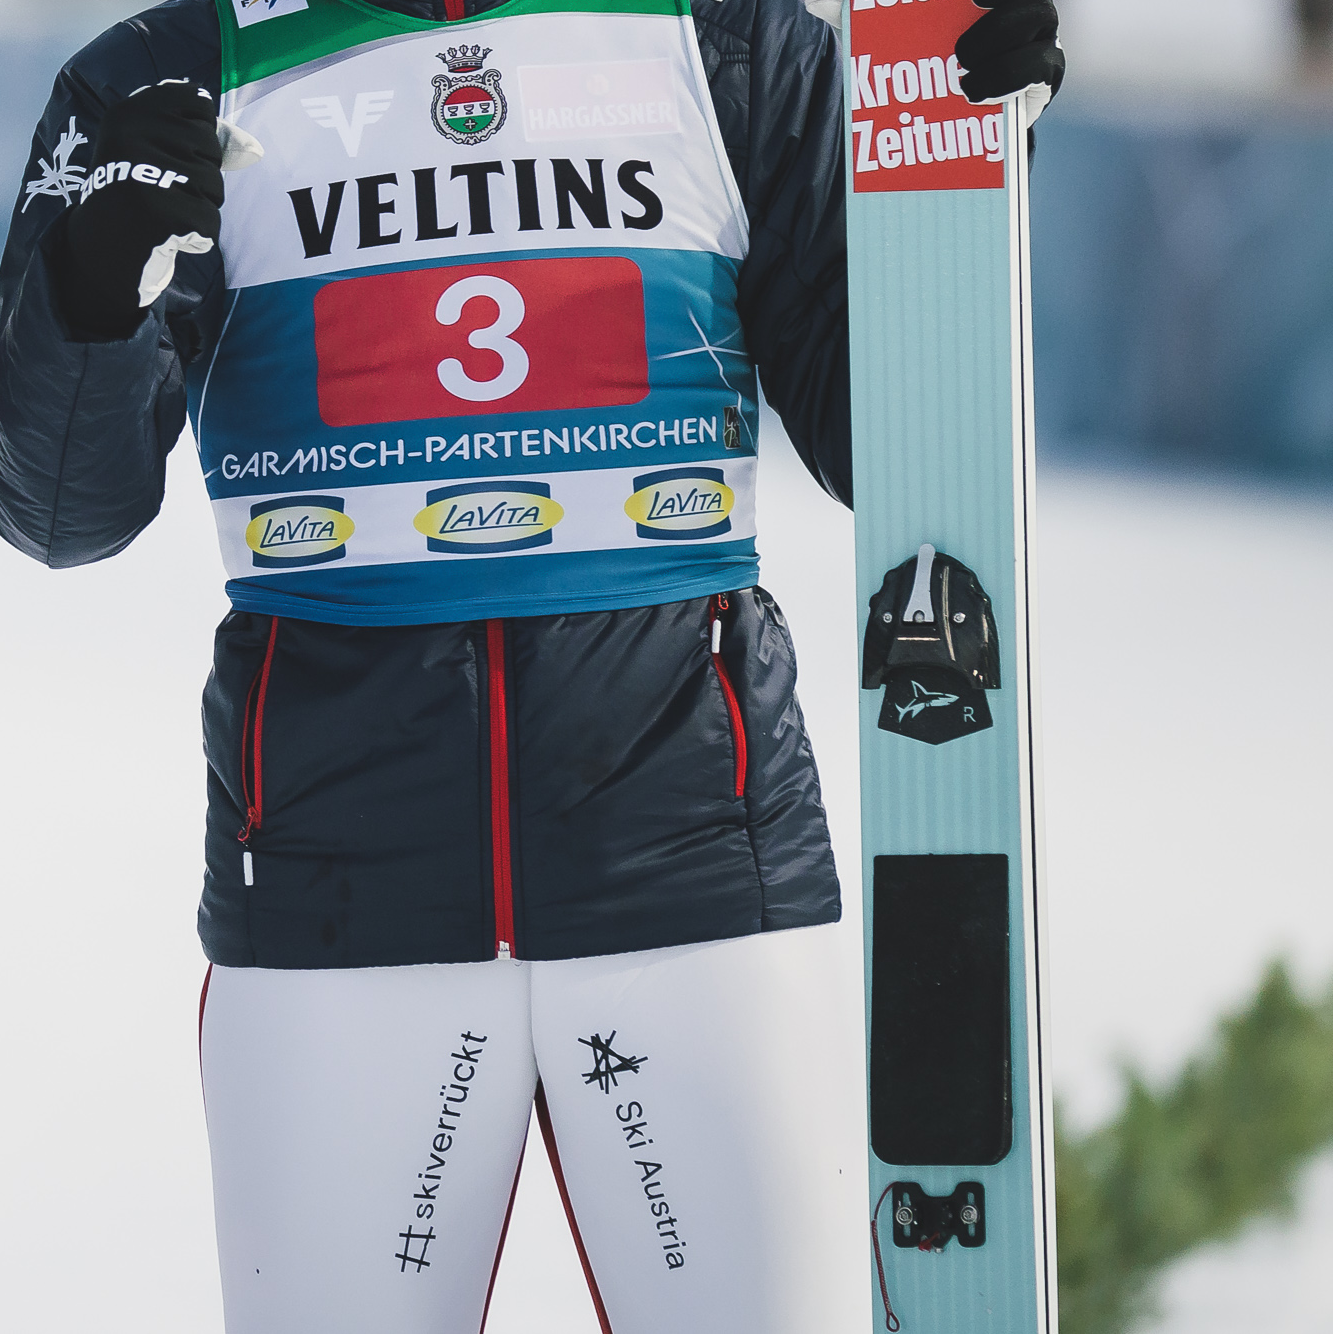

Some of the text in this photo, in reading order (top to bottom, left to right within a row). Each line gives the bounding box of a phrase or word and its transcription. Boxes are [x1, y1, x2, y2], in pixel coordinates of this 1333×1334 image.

[528, 101, 673, 131] HARGASSNER
[850, 54, 970, 110] Krone
[852, 111, 1005, 173] Zeitung
[287, 158, 664, 259] VELTINS
[435, 275, 530, 403] 3
[221, 415, 718, 480] GARMISCH-PARTENKIRCHEN
[394, 1030, 488, 1274] #skiverrückt
[615, 1099, 688, 1271] Ski Austria
